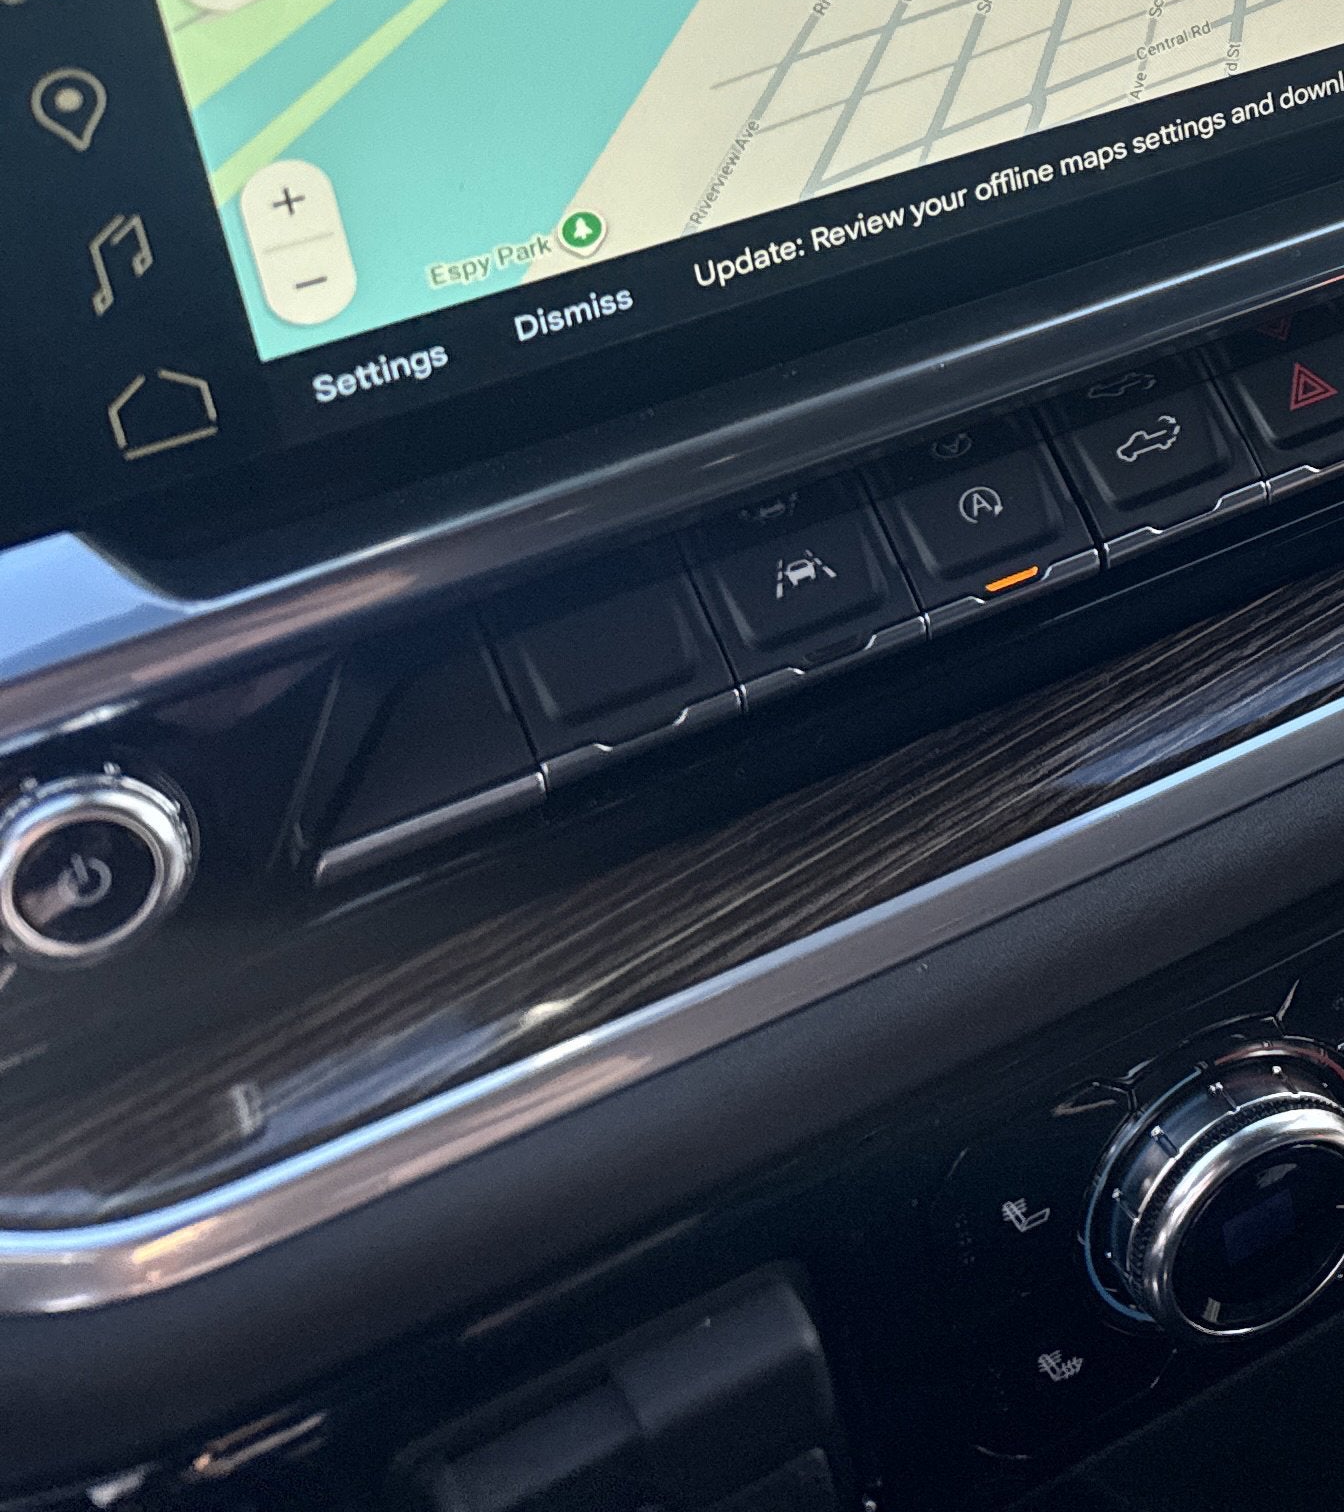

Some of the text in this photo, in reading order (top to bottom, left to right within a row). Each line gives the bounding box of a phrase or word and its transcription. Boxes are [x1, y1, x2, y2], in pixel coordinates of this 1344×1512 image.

[1136, 21, 1212, 61] Central Rd
[1227, 41, 1241, 59] St
[1130, 71, 1148, 100] Ave
[690, 119, 760, 225] Riverview Ave
[693, 237, 806, 288] Update:
[810, 207, 905, 252] Review
[909, 188, 968, 229] your
[974, 161, 1054, 202] offline
[1060, 141, 1128, 176] maps
[1131, 112, 1226, 154] settings
[1231, 91, 1275, 124] and
[430, 236, 553, 286] Espy Park
[514, 289, 635, 342] Dismiss
[311, 344, 450, 403] Settings
